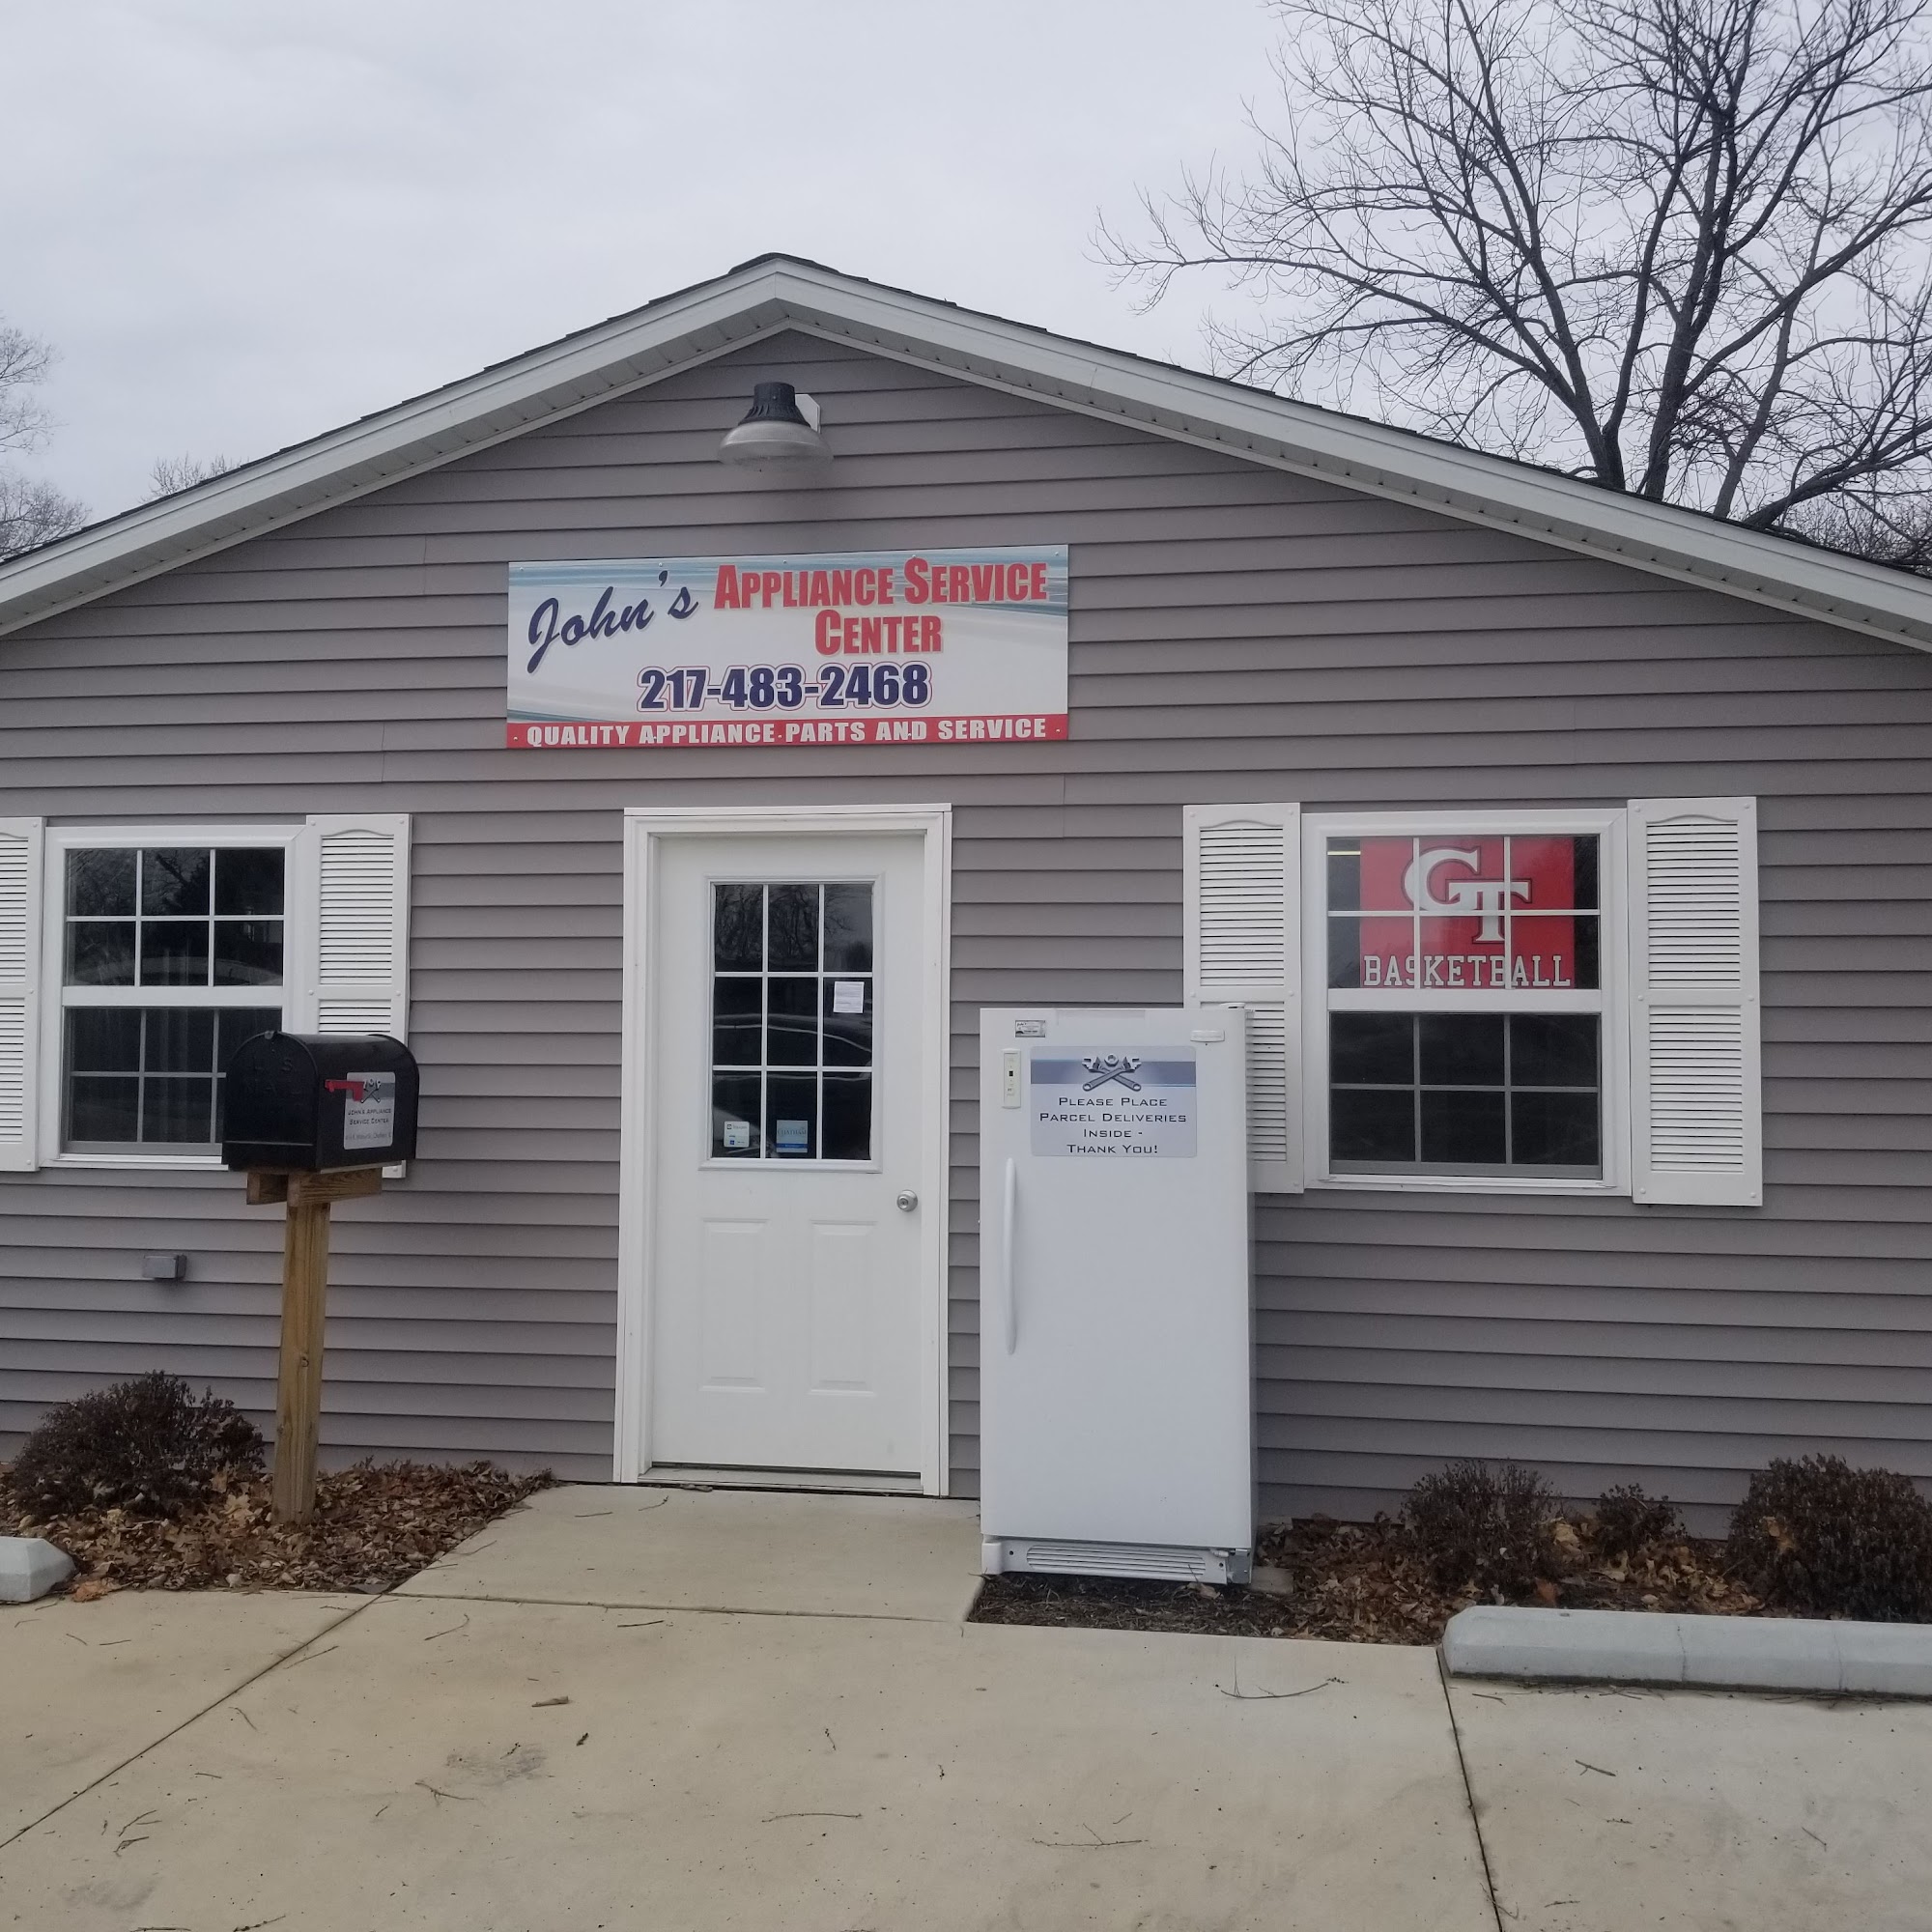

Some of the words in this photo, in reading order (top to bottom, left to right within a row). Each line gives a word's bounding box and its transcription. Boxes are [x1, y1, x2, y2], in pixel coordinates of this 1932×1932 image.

[713, 564, 894, 610] APPLIANCE
[903, 557, 1048, 606] SERVICE
[526, 570, 699, 674] John's
[814, 609, 943, 656] CENTER
[639, 663, 930, 712] 217-483-2468
[526, 724, 630, 748] QUALITY
[639, 723, 776, 745] APPLIANCE
[785, 721, 866, 743] PARTS
[875, 720, 927, 741] AND
[937, 717, 1046, 740] SERVICE
[1363, 954, 1571, 987] BASKETBALL
[1039, 1112, 1095, 1122] PARCEL
[1102, 1112, 1187, 1122] DELIVERIES
[1058, 1096, 1114, 1107] PLEASE
[1120, 1096, 1168, 1107] PLACE
[1066, 1144, 1117, 1154] THANK
[1122, 1144, 1158, 1154] YOU!
[1083, 1128, 1132, 1138] INSIDE
